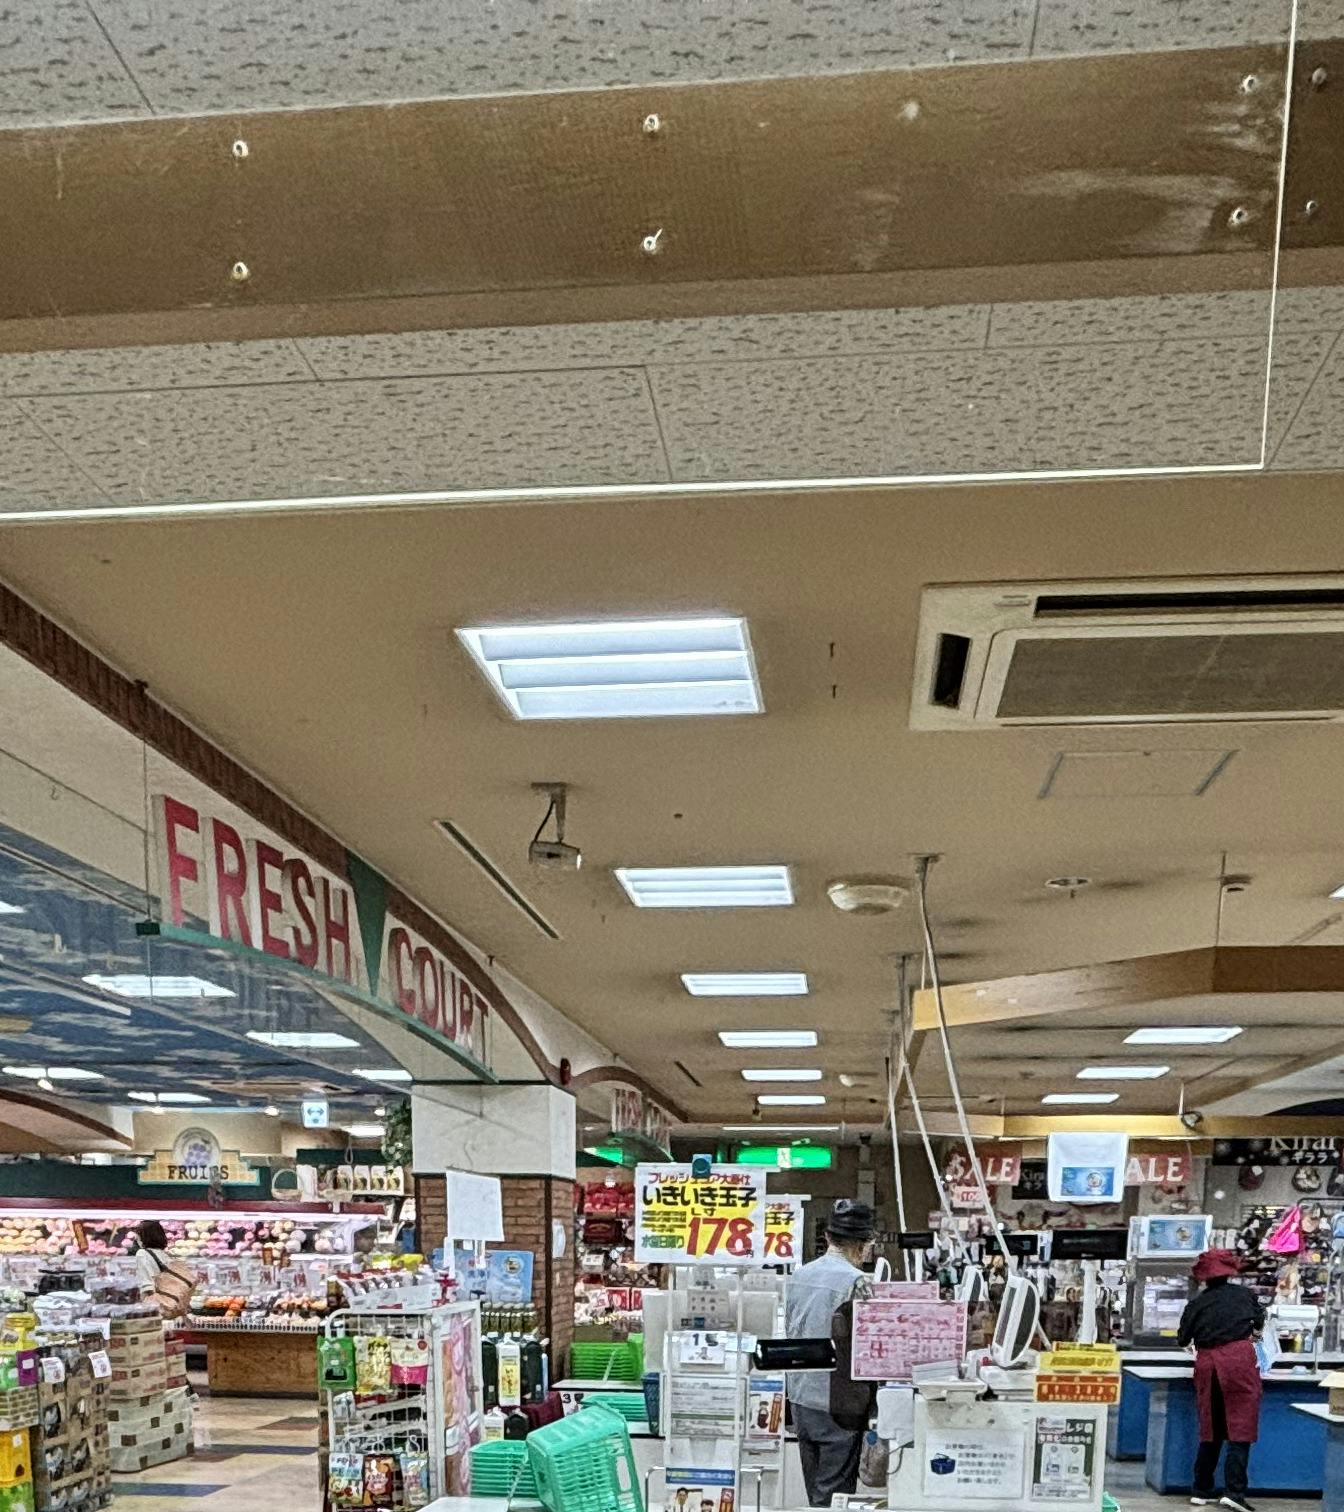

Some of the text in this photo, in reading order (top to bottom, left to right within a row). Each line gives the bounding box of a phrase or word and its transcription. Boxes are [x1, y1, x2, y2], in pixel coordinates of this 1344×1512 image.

[159, 794, 490, 1072] FRESH COURT
[1126, 1157, 1184, 1182] ALE
[642, 1185, 756, 1207] いきいき玉子
